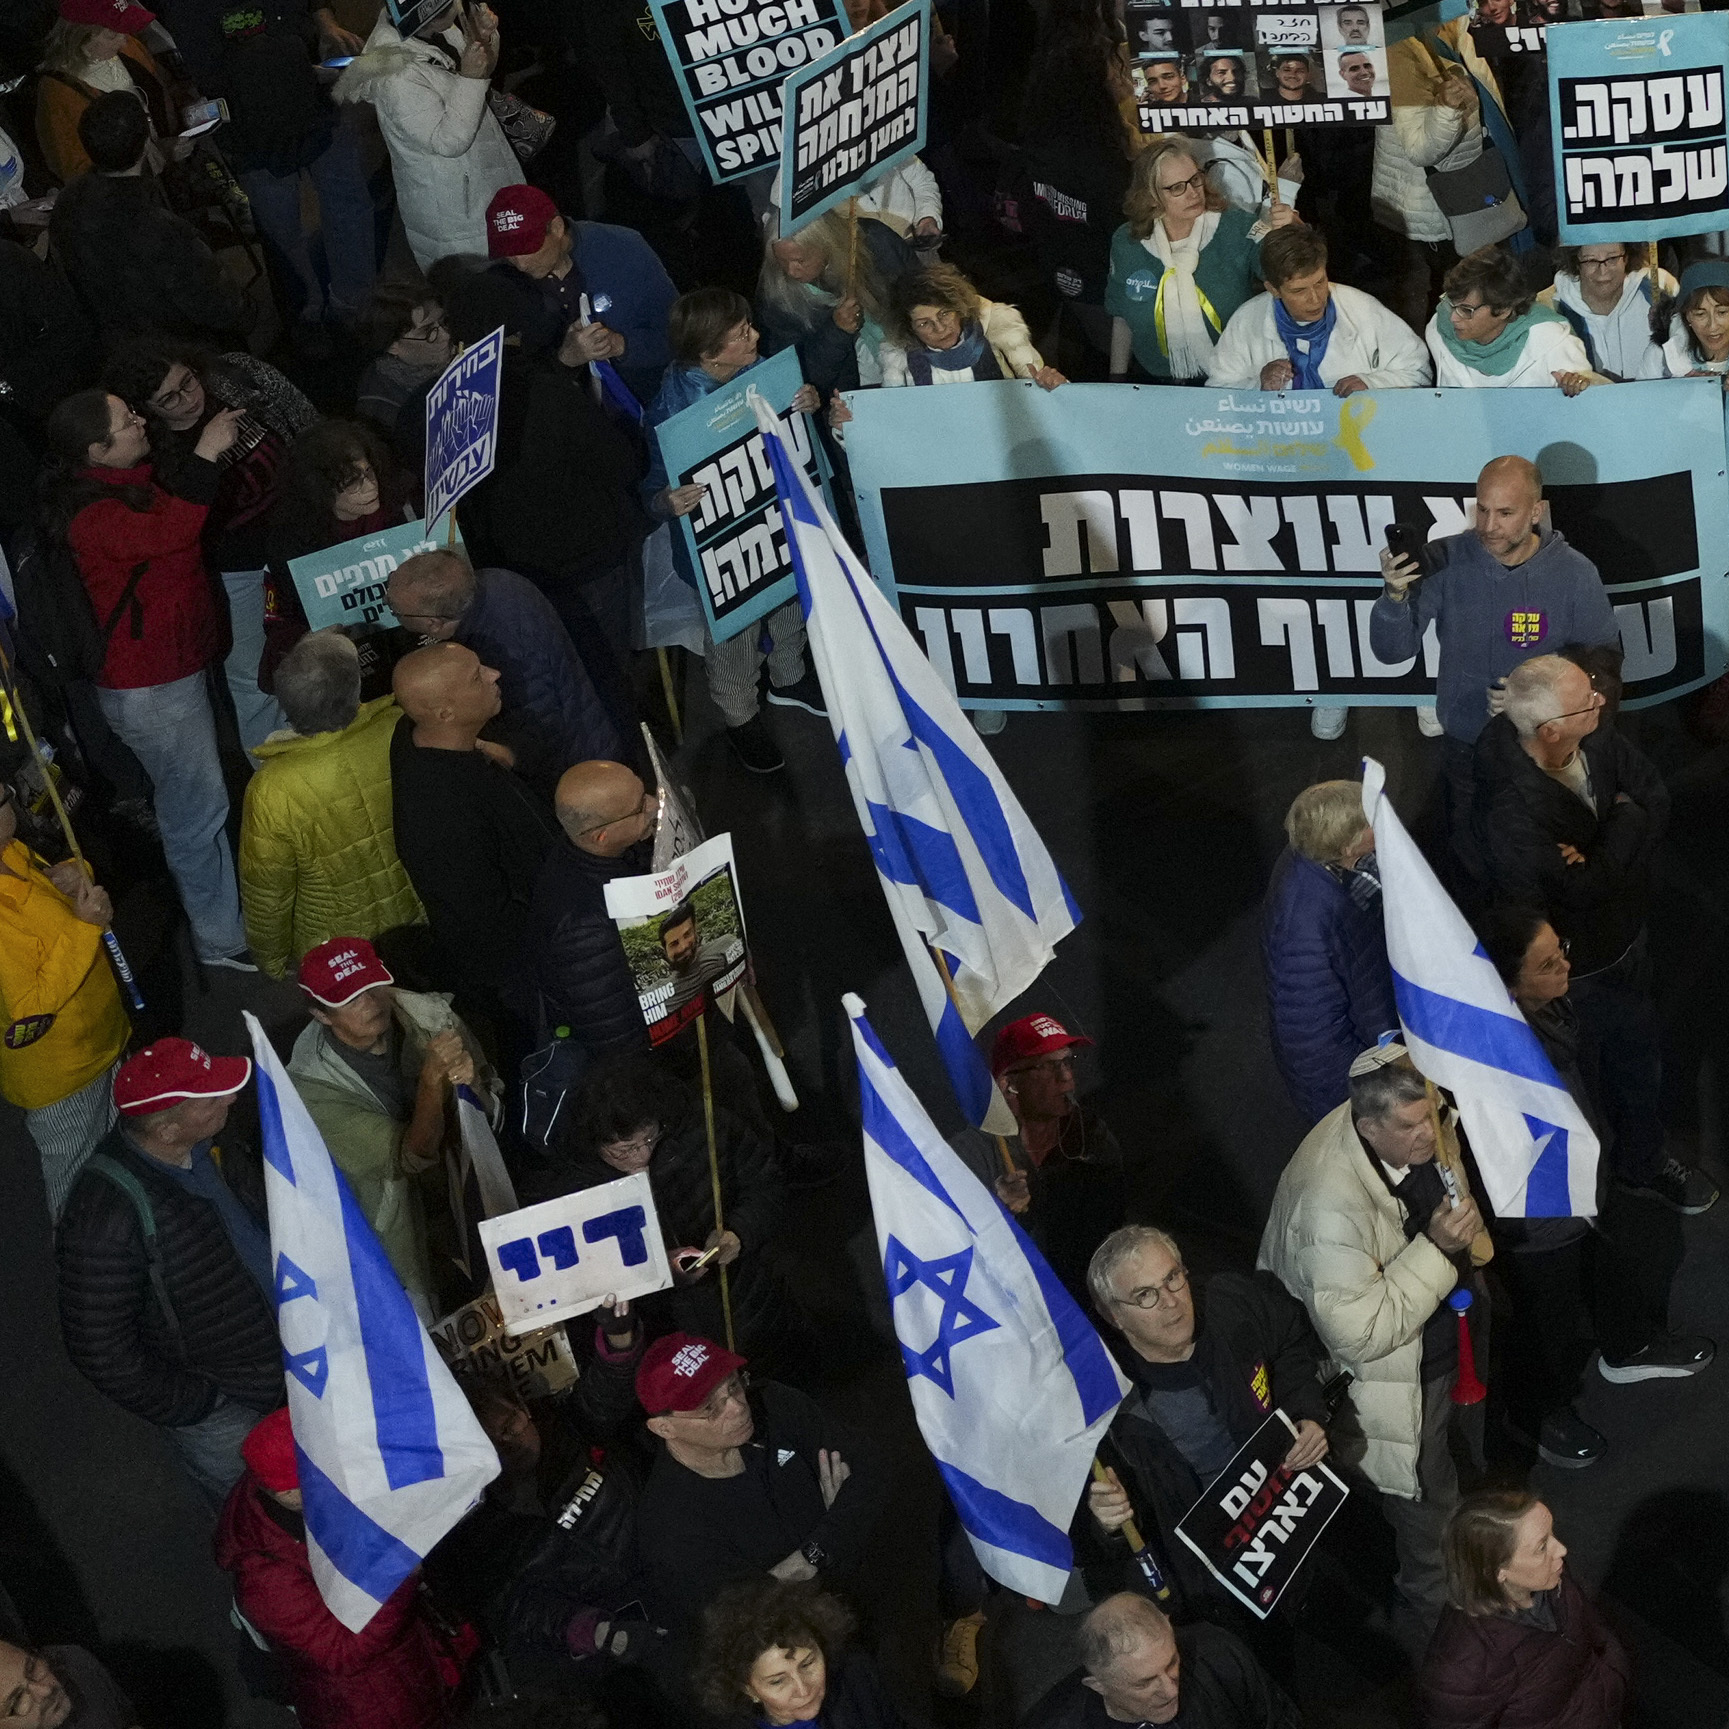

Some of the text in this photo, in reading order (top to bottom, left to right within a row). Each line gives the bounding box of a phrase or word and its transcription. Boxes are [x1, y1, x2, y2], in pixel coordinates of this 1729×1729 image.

[800, 19, 919, 120] עצרו את
[797, 60, 918, 172] המלחמה
[1139, 99, 1388, 134] עד החטוף האחרון!
[1563, 73, 1724, 143] עסקה.
[821, 106, 918, 190] למען כולנו
[1566, 143, 1729, 213] שלמה!
[497, 210, 517, 218] SEAL
[498, 223, 520, 232] DEAL
[507, 215, 524, 223] BIG
[1040, 488, 1392, 578] עוצרות
[328, 950, 358, 968] SEAL
[334, 962, 366, 981] DEAL
[340, 960, 354, 969] THE
[637, 981, 676, 1012] BRING
[643, 1002, 669, 1027] HIM
[672, 1345, 695, 1366] SEAL
[685, 1354, 709, 1377] DEAL
[1219, 1458, 1270, 1522] עם
[1232, 1472, 1324, 1590] בארצנו
